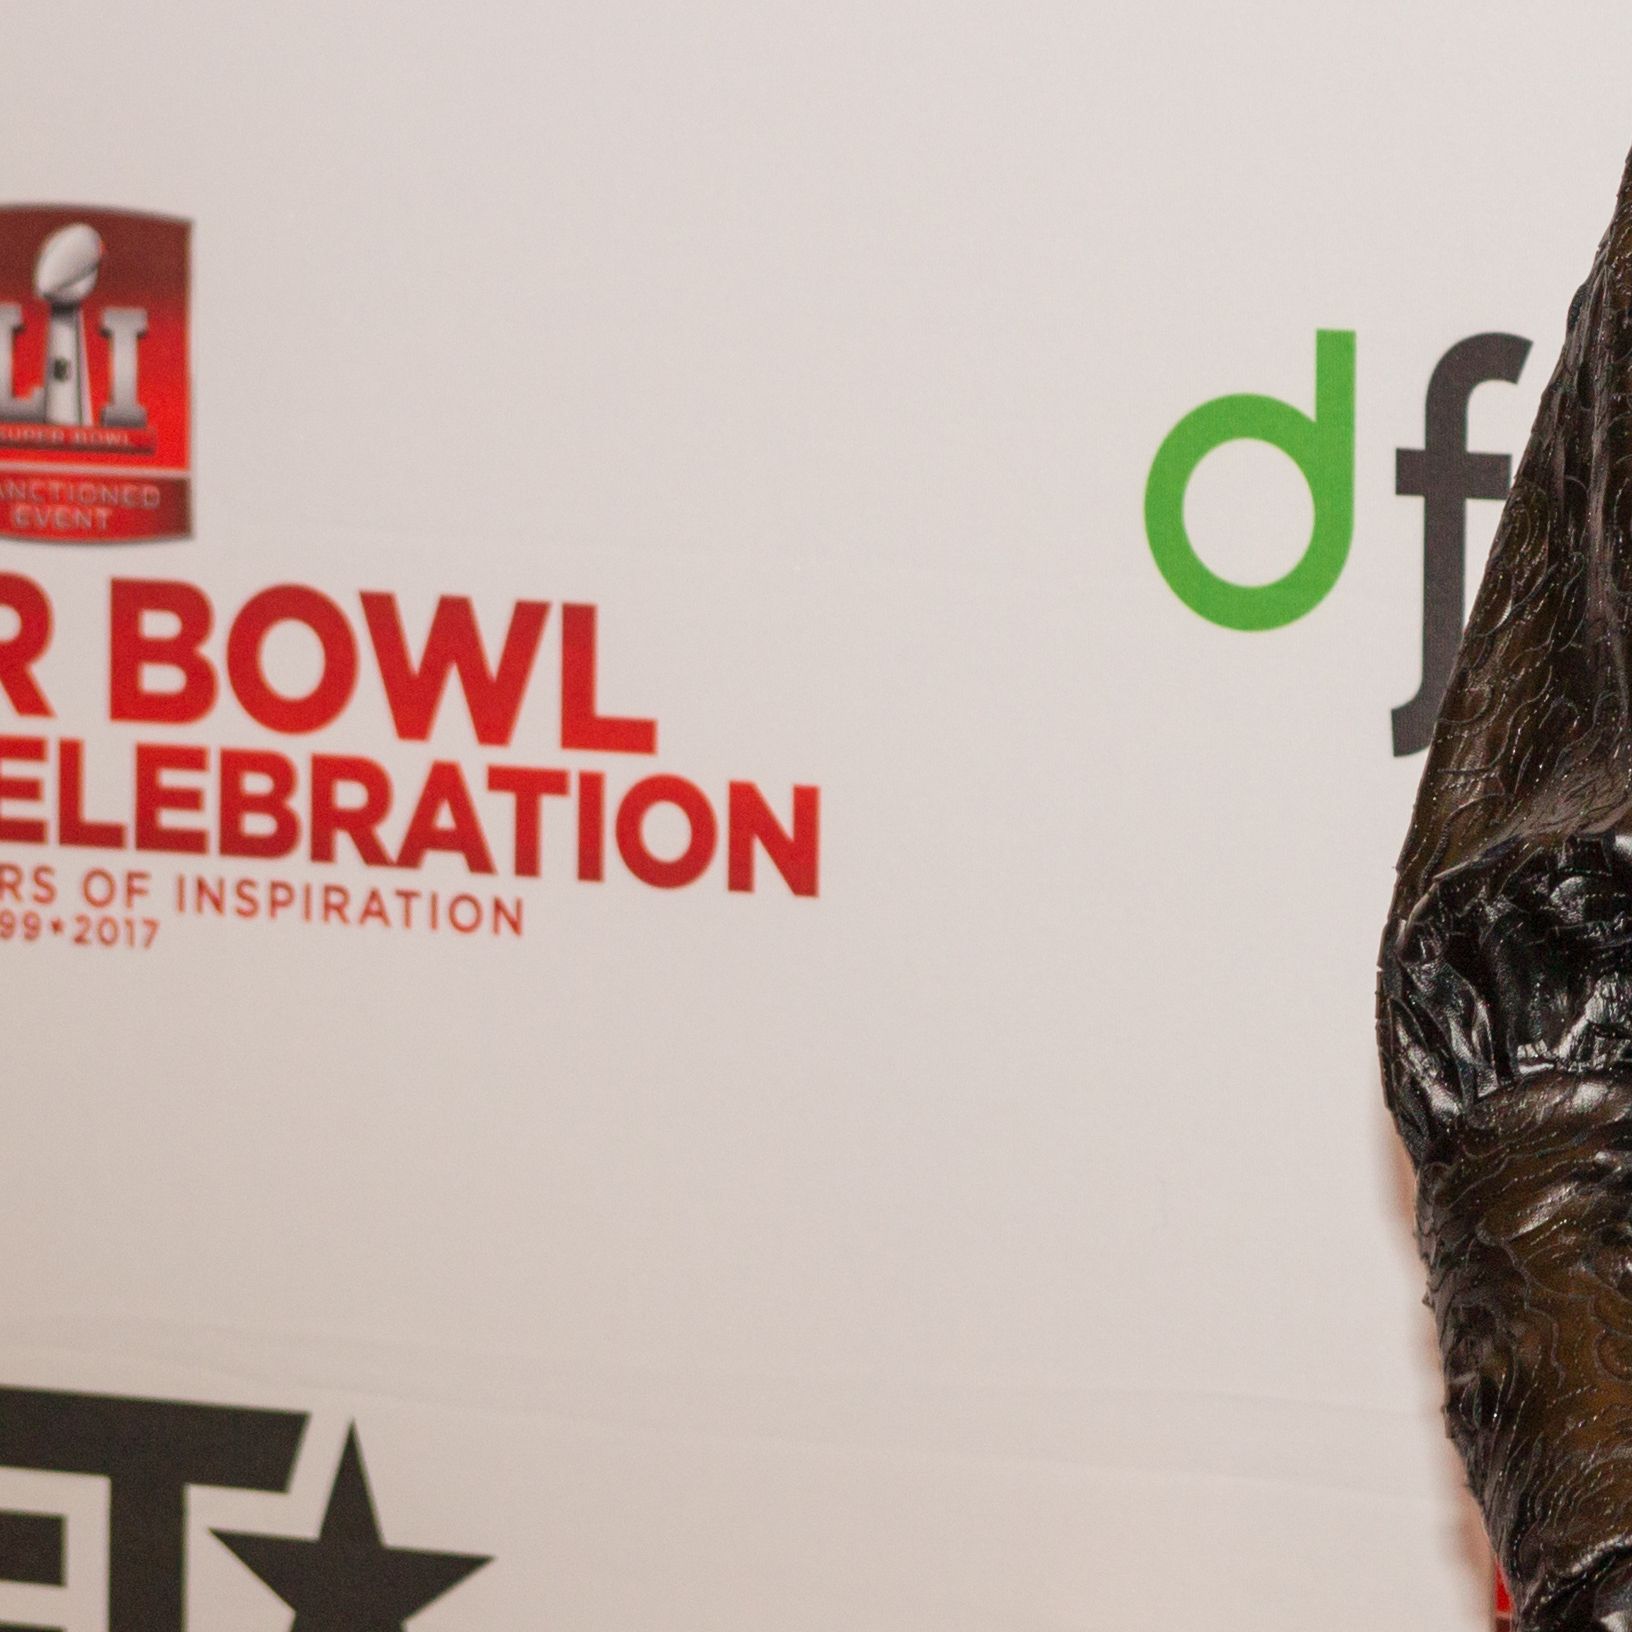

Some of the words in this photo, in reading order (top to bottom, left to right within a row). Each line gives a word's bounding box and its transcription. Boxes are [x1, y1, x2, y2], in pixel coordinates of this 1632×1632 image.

[13, 504, 113, 530] EVENT
[109, 578, 657, 758] BOWL
[82, 868, 149, 909] OF
[177, 873, 524, 936] INSPIRATION
